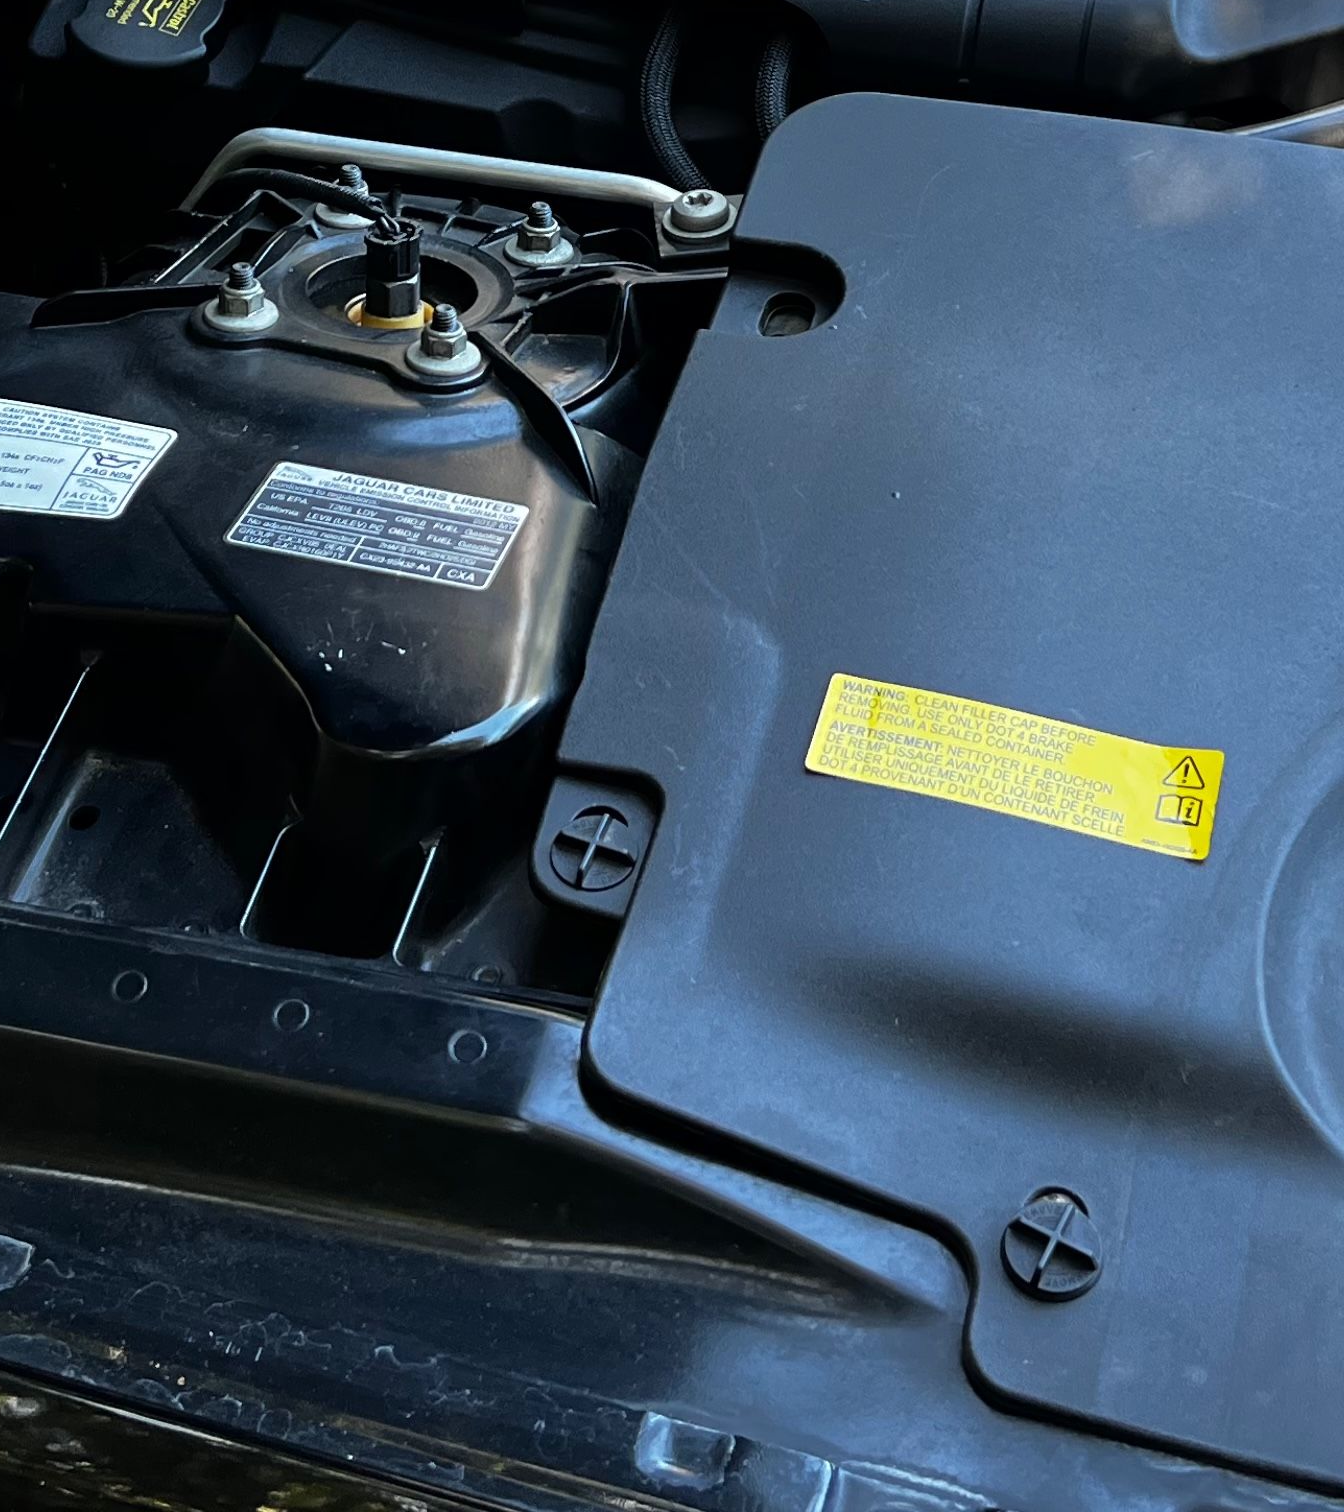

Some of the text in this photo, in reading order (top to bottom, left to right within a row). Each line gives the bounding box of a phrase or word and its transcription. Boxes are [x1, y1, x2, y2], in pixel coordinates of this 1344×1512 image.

[1, 406, 41, 416] CAUTION
[40, 412, 76, 422] SYSTEM
[57, 427, 105, 440] QUALIFIED
[0, 451, 21, 459] 134a
[101, 430, 151, 442] PRESSURE
[81, 466, 134, 479] PAG ND8
[62, 491, 118, 503] JAGUAR
[269, 480, 315, 493] Conforms
[498, 522, 515, 530] MY
[317, 480, 520, 522] VEHICLE EMISSION CONTROL INFORMATION
[331, 473, 516, 514] JAGUAR CARS LIMITED
[255, 502, 301, 515] California
[368, 523, 385, 531] PC
[386, 527, 411, 536] OBD
[425, 534, 453, 545] FUEL
[456, 540, 499, 553] Gasoline
[261, 520, 319, 536] adjustments
[319, 531, 356, 542] needed
[269, 492, 287, 500] US
[286, 495, 310, 504] EPA
[355, 508, 378, 517] LDV
[393, 515, 418, 525] OBD
[432, 522, 460, 533] FUEL
[463, 528, 506, 541] Gasoline
[444, 568, 478, 582] CXA
[834, 703, 873, 720] FLUID
[875, 711, 915, 729] FROM
[917, 720, 928, 732] A
[929, 722, 983, 744] SEALED
[842, 679, 1097, 746] WARNING: CLEAN FILLER CAP BEFORE
[915, 707, 944, 722] USE
[947, 713, 982, 731] ONLY
[985, 722, 1015, 738] DOT
[1016, 730, 1025, 740] 4
[1027, 733, 1074, 753] BRAKE
[825, 731, 846, 745] DE
[847, 735, 943, 766] REMPLISSAGE
[944, 757, 989, 776] AVANT
[991, 768, 1011, 782] DE
[1013, 773, 1031, 787] LE
[829, 719, 1114, 794] AVERTISSEMENT: NETTOYER LE BOUCHON
[818, 755, 851, 771] DOT
[849, 762, 858, 773] 4
[860, 764, 945, 792] PROVENANT
[946, 782, 981, 800] D'UN
[981, 790, 1068, 821] CONTENANT
[821, 743, 1124, 824] UTILISER UNIQUEMENT DU LIQUIDE DE FREIN
